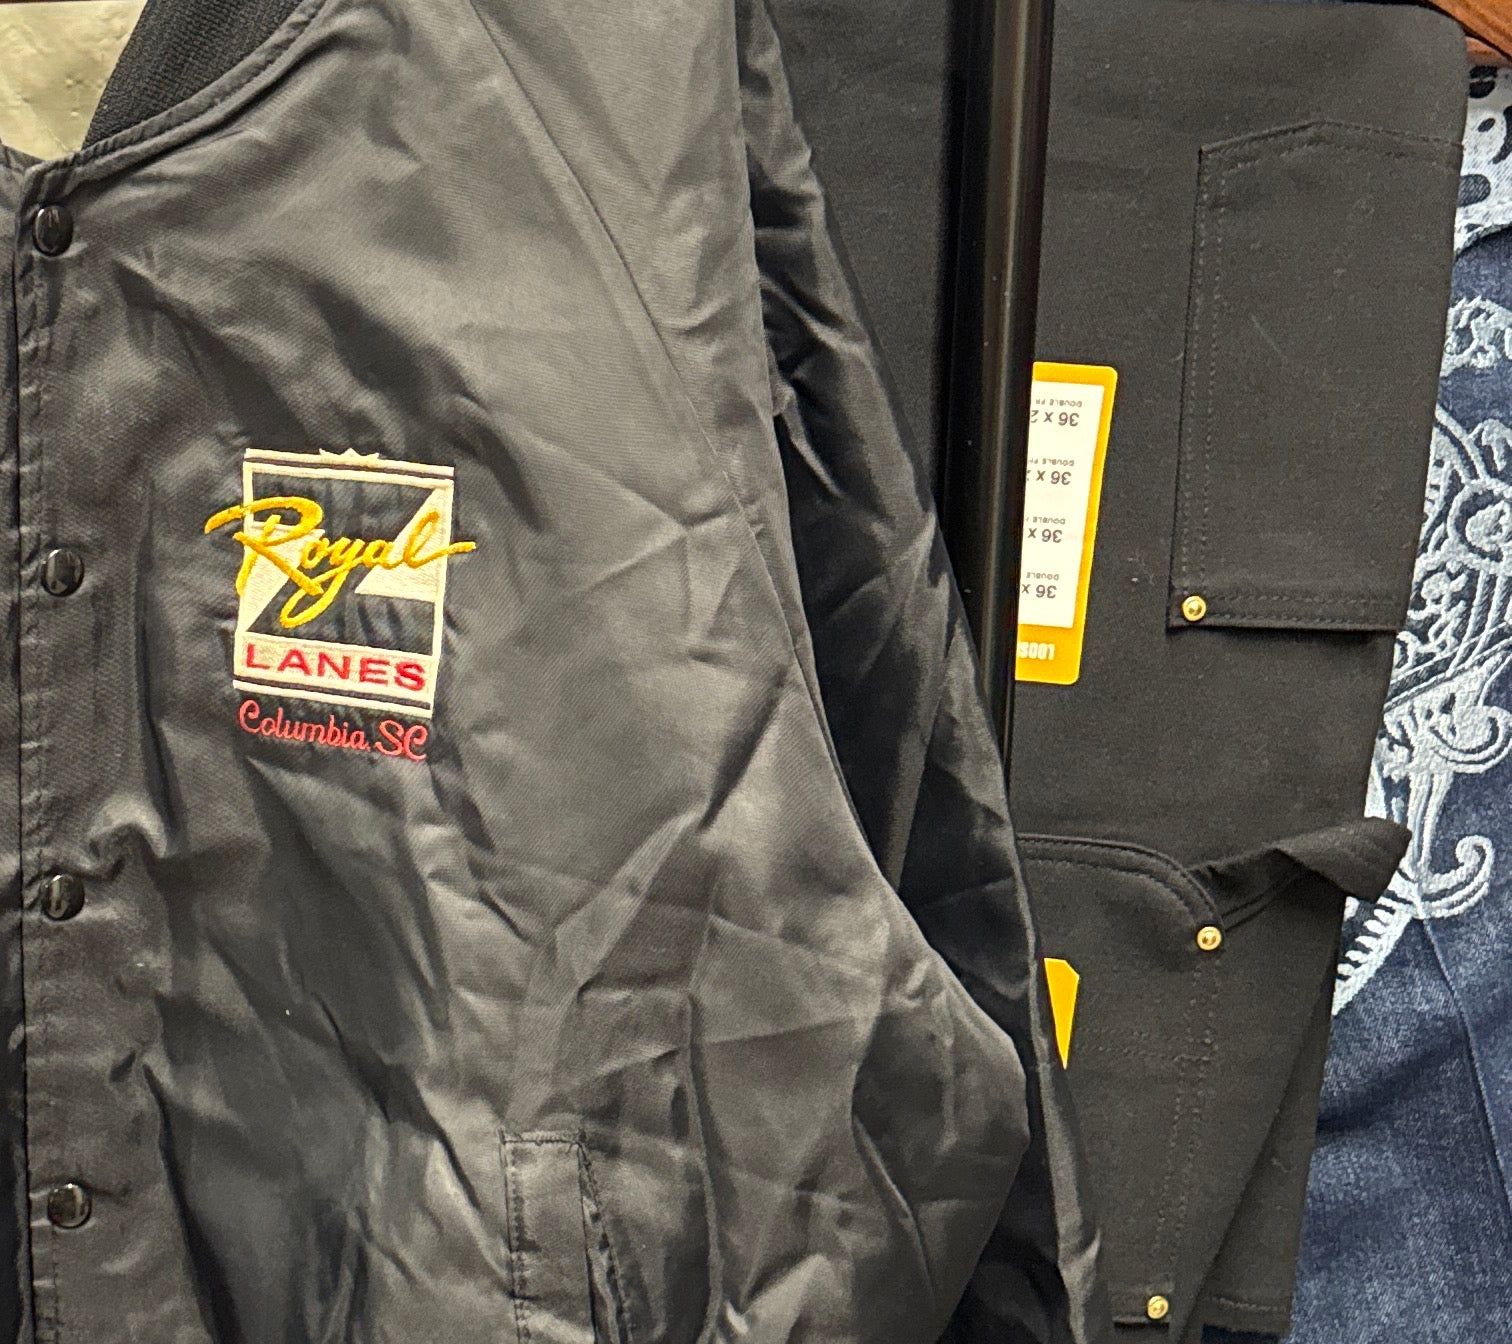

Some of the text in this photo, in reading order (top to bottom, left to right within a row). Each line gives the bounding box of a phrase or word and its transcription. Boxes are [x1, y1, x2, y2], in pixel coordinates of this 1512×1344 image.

[1044, 412, 1054, 423] x
[1058, 412, 1080, 427] 36
[1036, 470, 1046, 481] x
[1050, 470, 1072, 485] 36
[1027, 528, 1063, 543] 36 x
[204, 495, 476, 628] Royal
[1021, 584, 1057, 599] 36 x
[245, 643, 426, 692] LANES
[375, 719, 428, 762] SC
